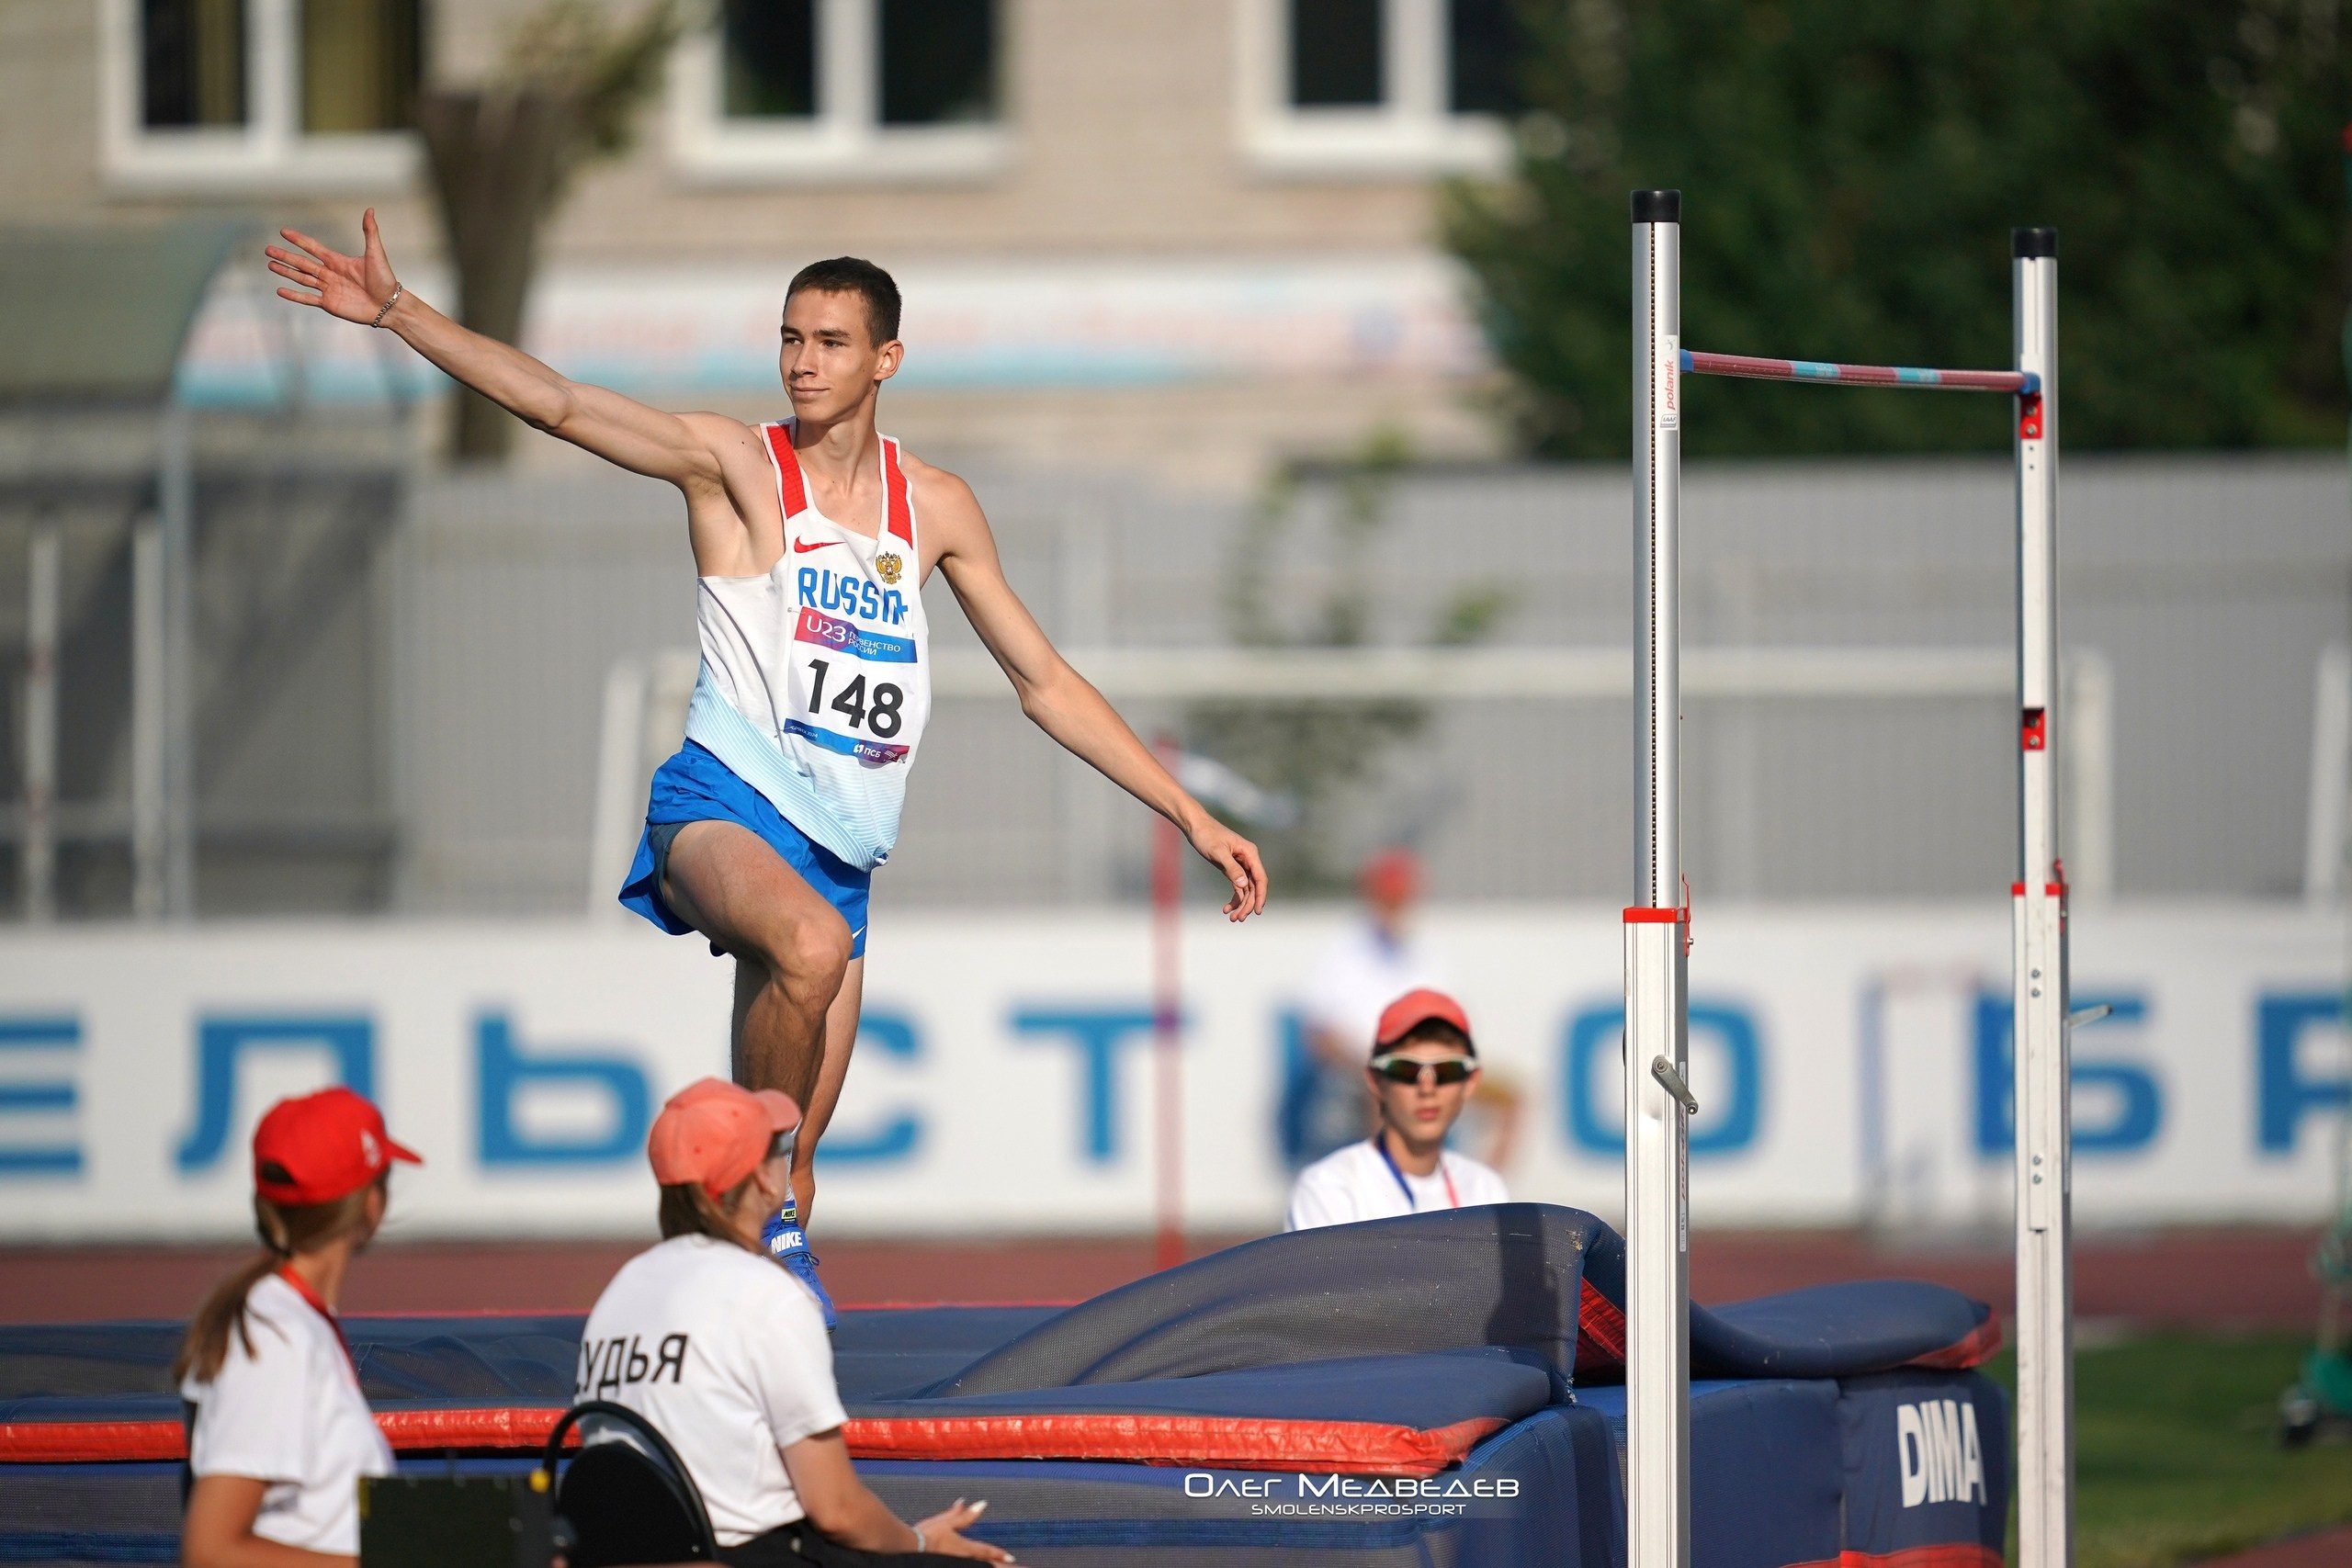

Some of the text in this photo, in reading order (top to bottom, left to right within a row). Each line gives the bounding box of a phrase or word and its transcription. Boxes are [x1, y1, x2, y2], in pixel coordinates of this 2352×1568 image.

[1665, 360, 1676, 411] polanik
[797, 567, 909, 626] RUSSIA
[806, 615, 846, 643] U23
[848, 637, 877, 656] РОССИИ
[808, 659, 904, 739] 148
[864, 747, 882, 759] ПСБ
[783, 1209, 796, 1218] NIKE
[771, 1231, 803, 1255] NIKE
[574, 1332, 689, 1401] УДЬЯ
[1896, 1399, 1988, 1508] DIMA
